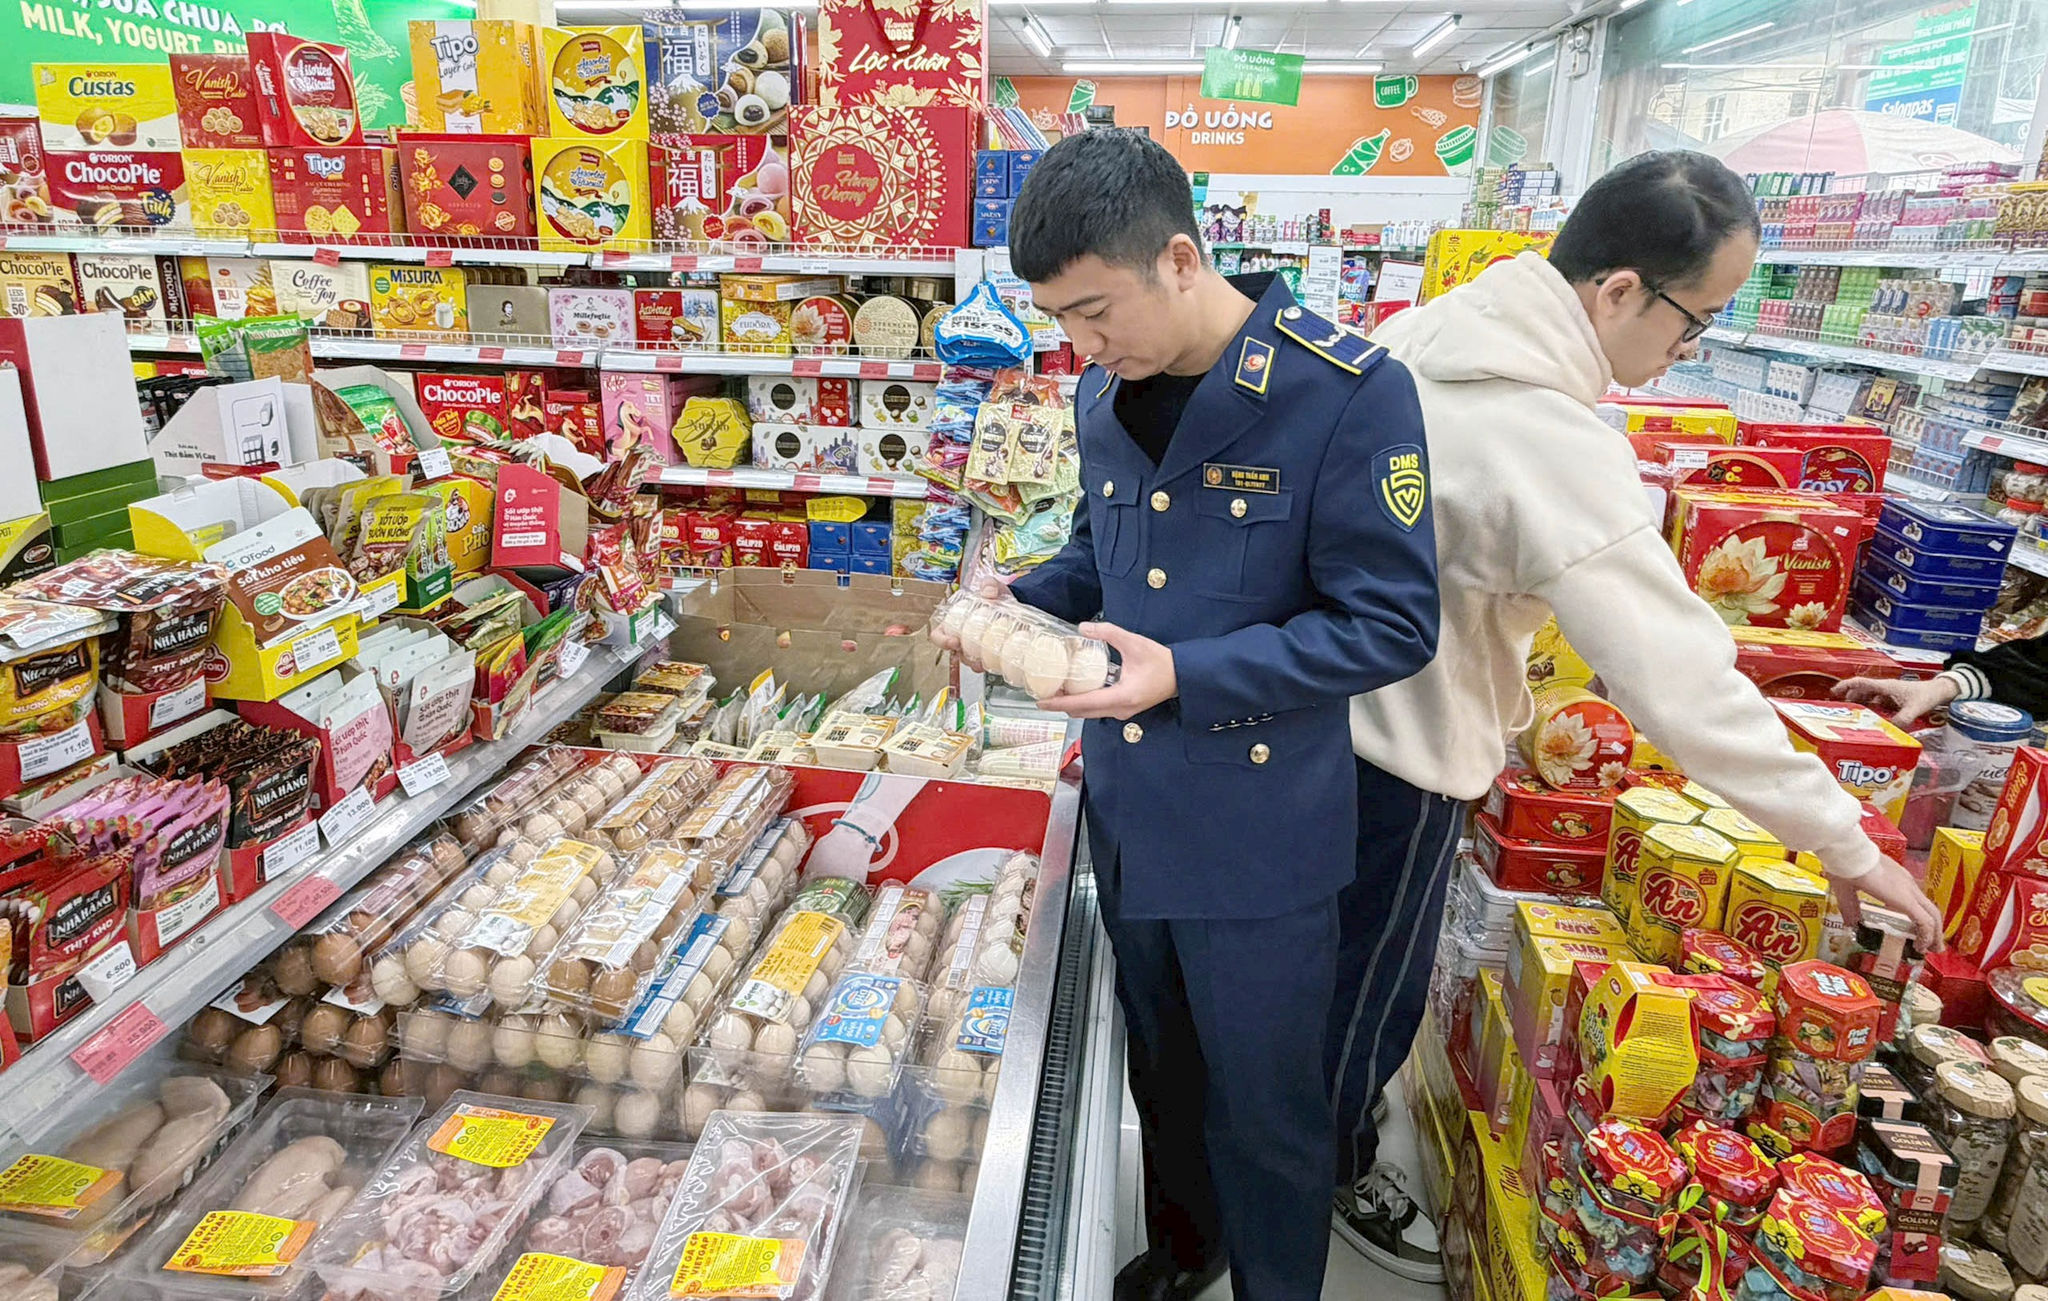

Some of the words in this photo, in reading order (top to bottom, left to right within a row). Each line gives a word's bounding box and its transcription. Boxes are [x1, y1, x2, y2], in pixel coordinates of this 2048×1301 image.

[20, 1, 103, 45] MILK,
[104, 17, 201, 54] YOGURT
[430, 35, 479, 63] Tipo
[663, 38, 692, 74] 福
[849, 43, 888, 74] Lộc
[68, 77, 135, 97] Custas
[1380, 85, 1401, 97] COFFEE
[1165, 103, 1199, 129] ĐỒ
[1205, 104, 1273, 129] UỐNG
[1191, 131, 1245, 145] DRINKS
[98, 154, 133, 164] ORION
[304, 153, 345, 179] Tipo
[65, 161, 162, 185] ChocoPie
[669, 162, 698, 198] 福
[0, 259, 64, 276] ChocoPie
[82, 262, 153, 280] ChocoPie
[292, 269, 333, 290] Coffee
[162, 260, 179, 313] ChocoPie
[311, 286, 337, 305] Joy
[424, 384, 501, 404] ChocoPie
[1389, 453, 1419, 471] DMS
[260, 564, 282, 579] kho
[283, 553, 306, 568] tiêu
[1779, 553, 1833, 571] Vanish
[153, 632, 177, 651] NHÀ
[177, 621, 208, 644] HÀNG
[64, 737, 90, 756] 11.100
[1836, 760, 1893, 787] Tipo
[255, 787, 279, 809] NHÀ
[278, 772, 308, 797] HÀNG
[191, 823, 219, 851] HÀNG
[1614, 835, 1641, 873] A
[55, 911, 81, 935] NHÀ
[79, 892, 113, 922] HÀNG
[92, 918, 114, 940] KHO
[64, 986, 84, 1003] NH
[1897, 1213, 1940, 1227] GOLDEN
